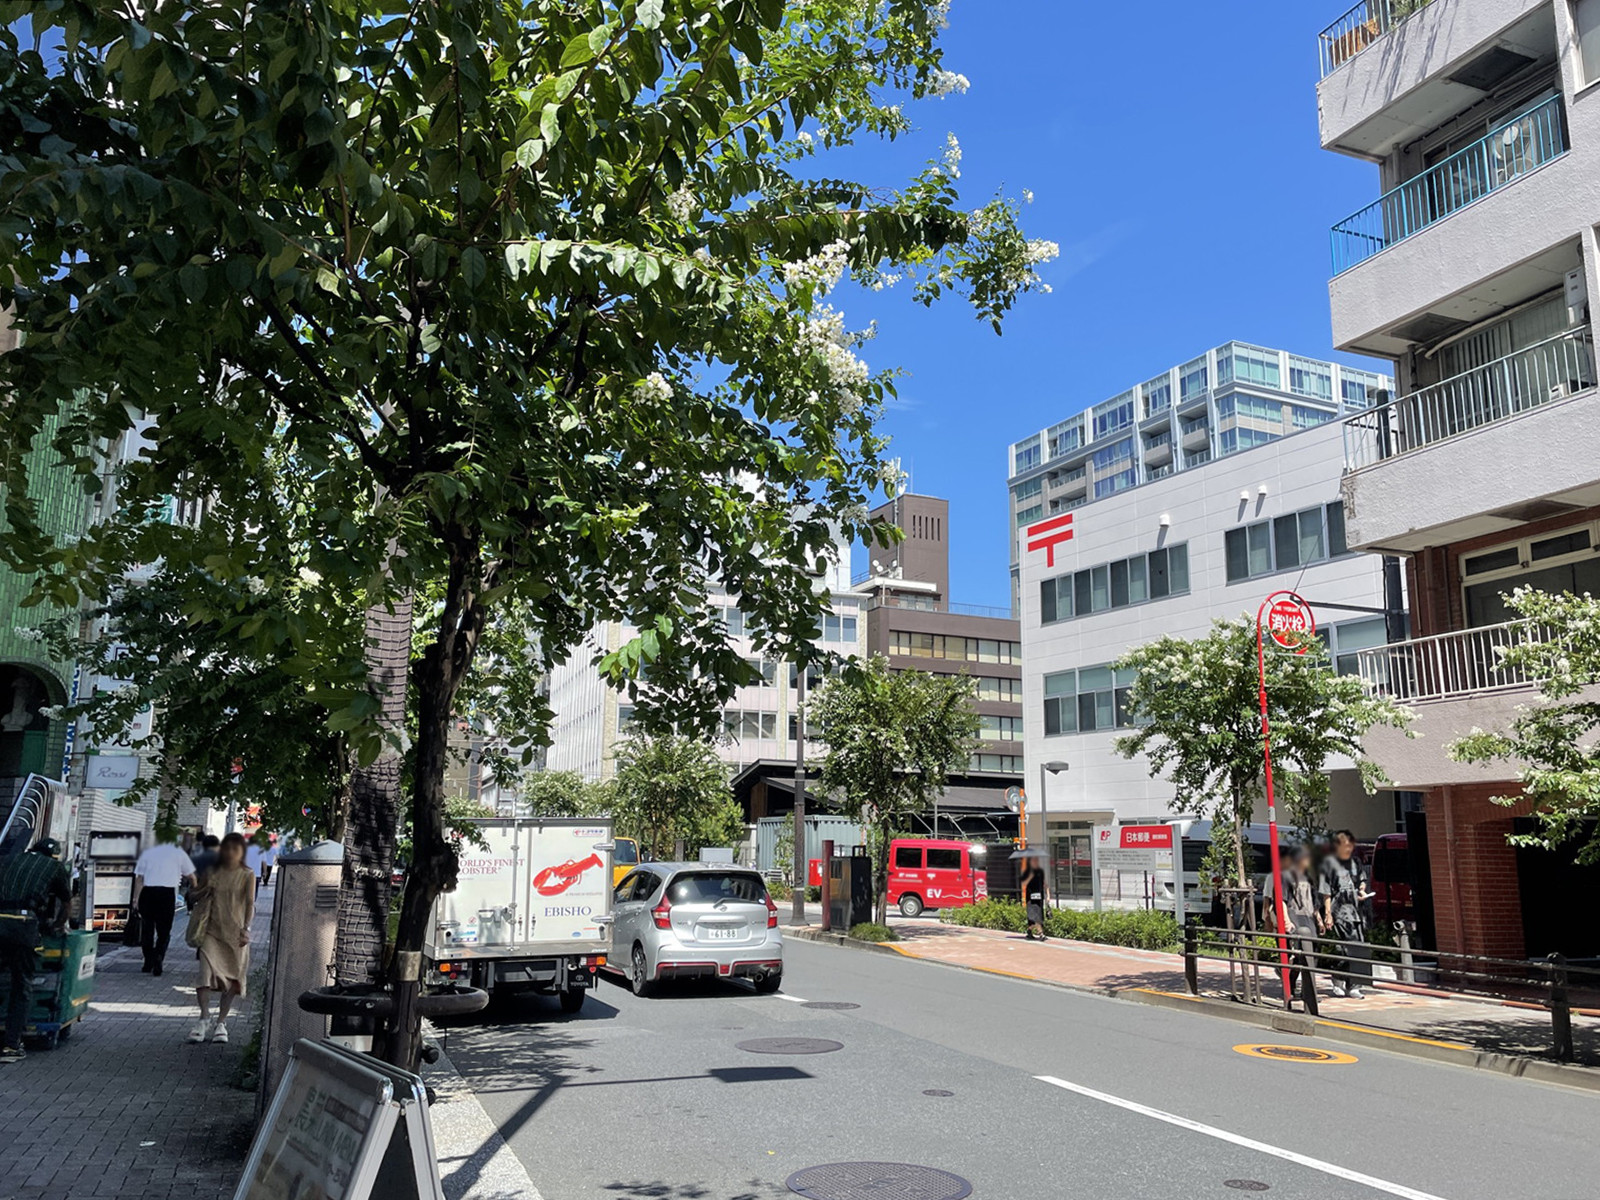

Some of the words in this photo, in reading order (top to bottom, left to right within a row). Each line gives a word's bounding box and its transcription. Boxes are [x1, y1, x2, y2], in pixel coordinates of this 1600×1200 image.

[1271, 613, 1304, 632] 消火栓
[1126, 832, 1150, 843] 日本郵便
[459, 859, 493, 867] ORLD'S
[926, 888, 942, 898] EV
[544, 906, 592, 917] EBISHO
